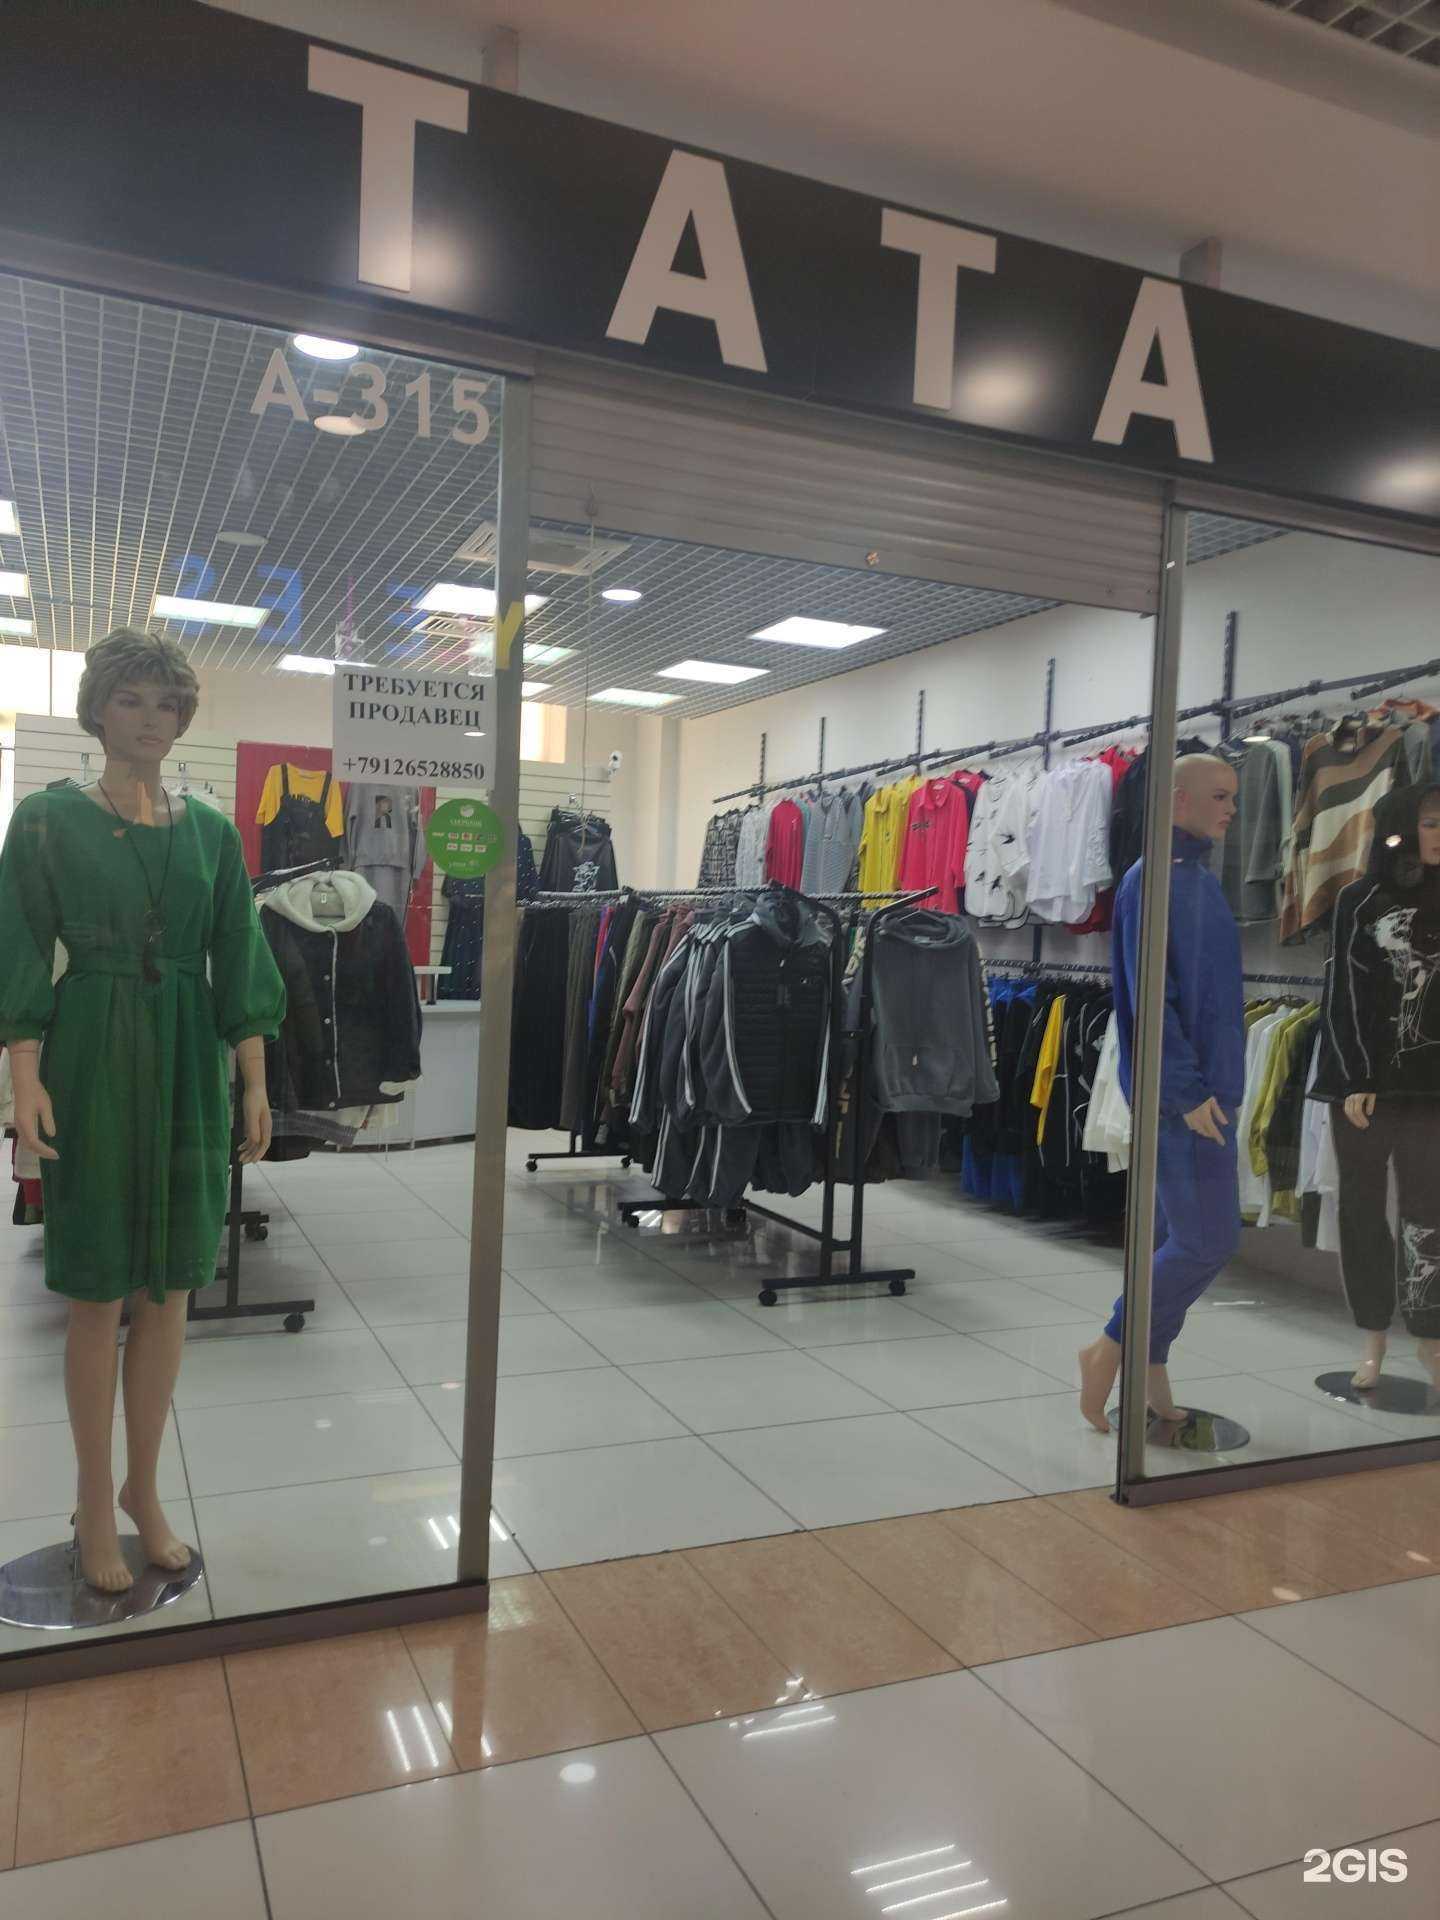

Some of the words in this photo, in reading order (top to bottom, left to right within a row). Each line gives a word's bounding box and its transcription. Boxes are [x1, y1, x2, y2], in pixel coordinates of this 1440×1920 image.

[343, 673, 485, 701] ТРЕБУЕТСЯ
[349, 701, 481, 731] ПРОДАВЕЦ
[343, 756, 485, 780] +79126528850
